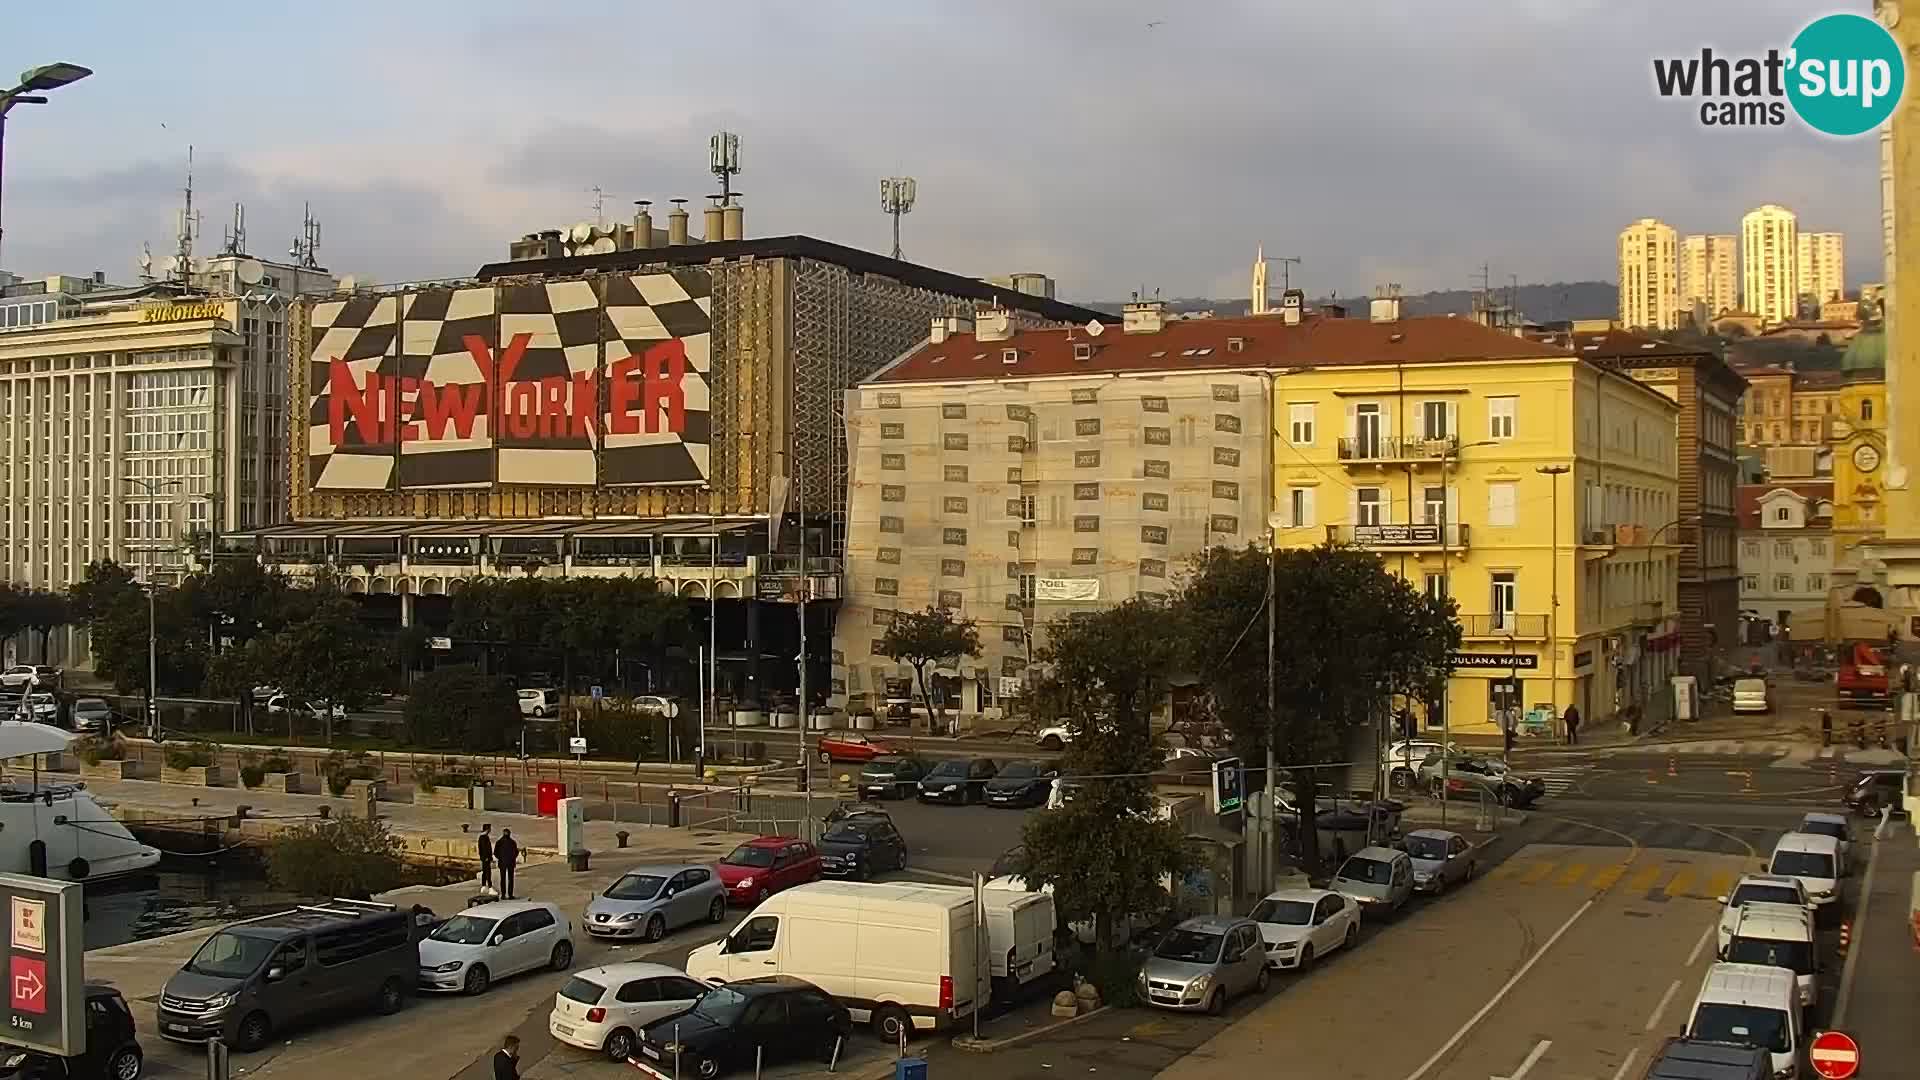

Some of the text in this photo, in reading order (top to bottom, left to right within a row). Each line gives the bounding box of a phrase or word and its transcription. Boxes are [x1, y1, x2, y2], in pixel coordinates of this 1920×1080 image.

[1451, 656, 1533, 666] JULIANA NAILS
[12, 1015, 33, 1029] 5 km
